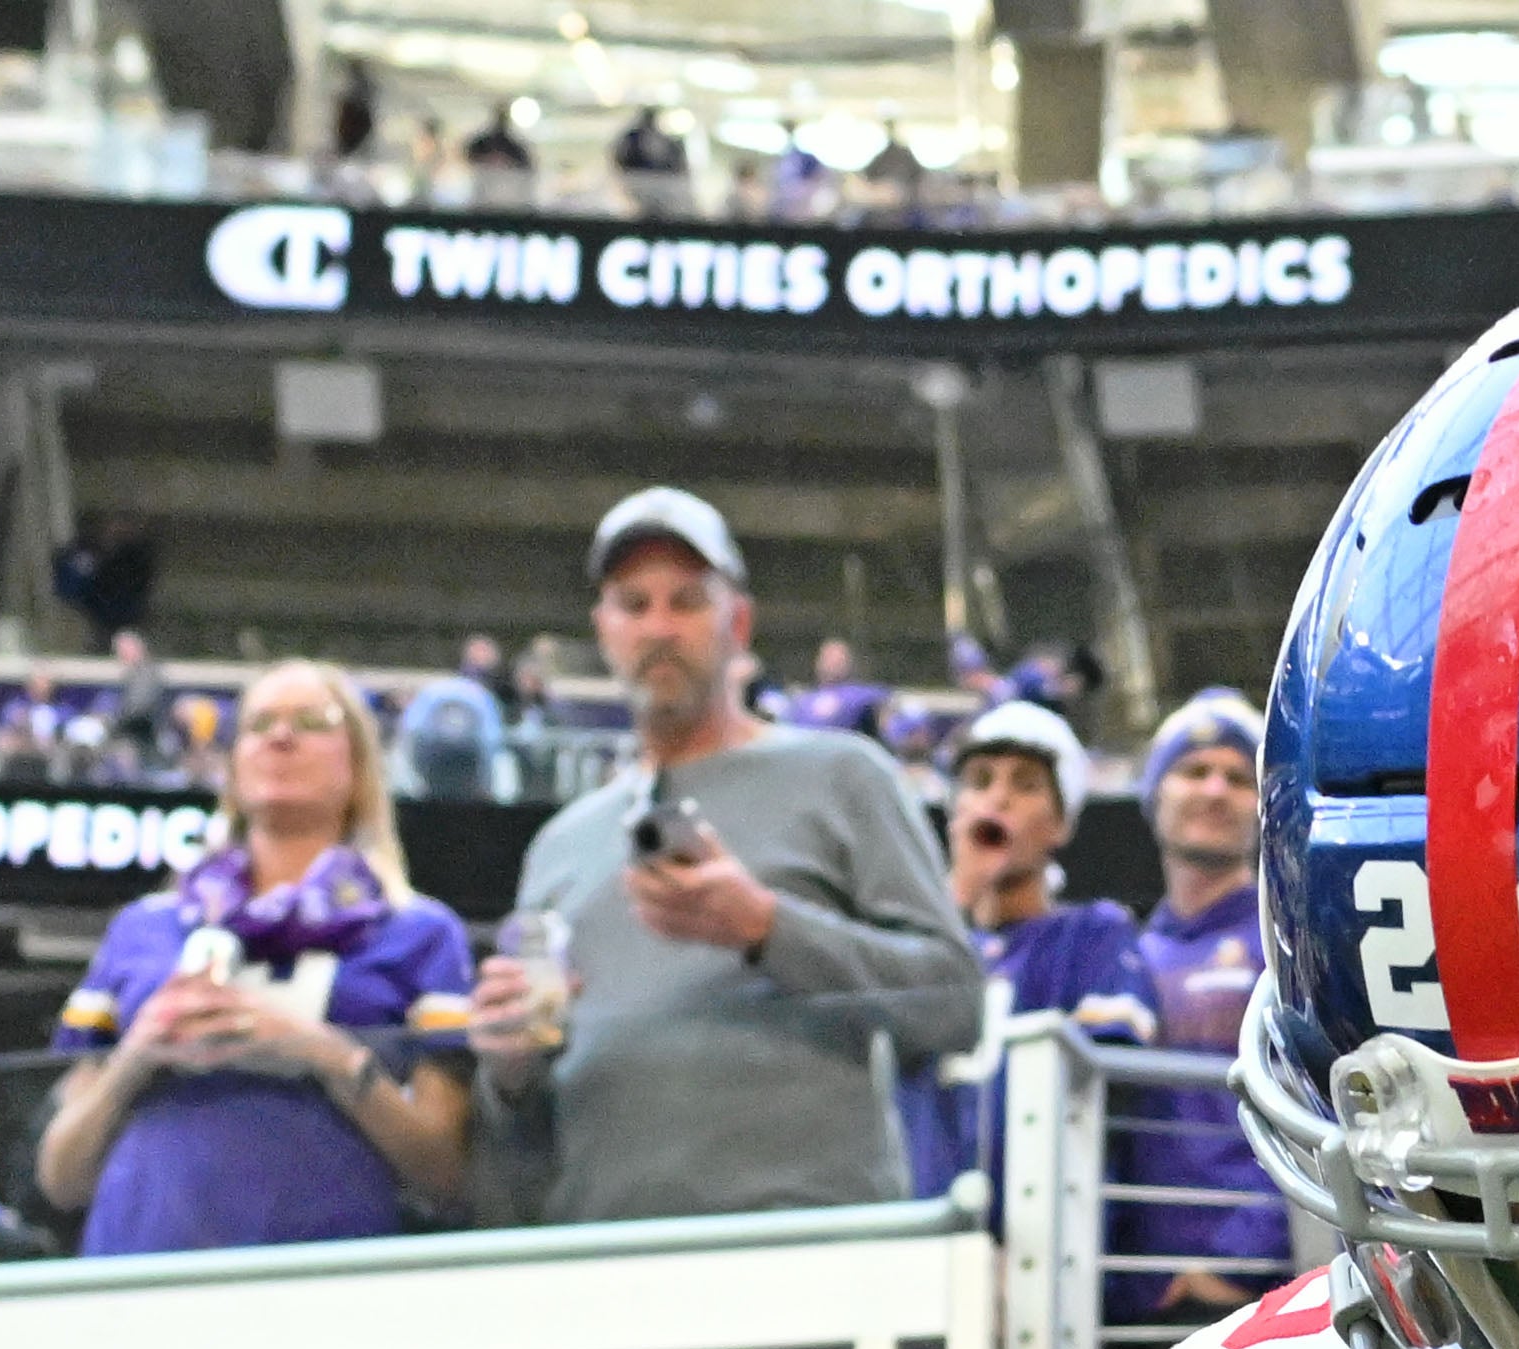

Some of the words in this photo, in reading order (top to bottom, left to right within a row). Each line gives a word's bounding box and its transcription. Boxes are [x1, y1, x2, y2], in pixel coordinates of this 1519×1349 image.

[384, 227, 580, 302] TWIN
[597, 237, 829, 313] CITIES
[845, 236, 1351, 317] ORTHOPEDICS
